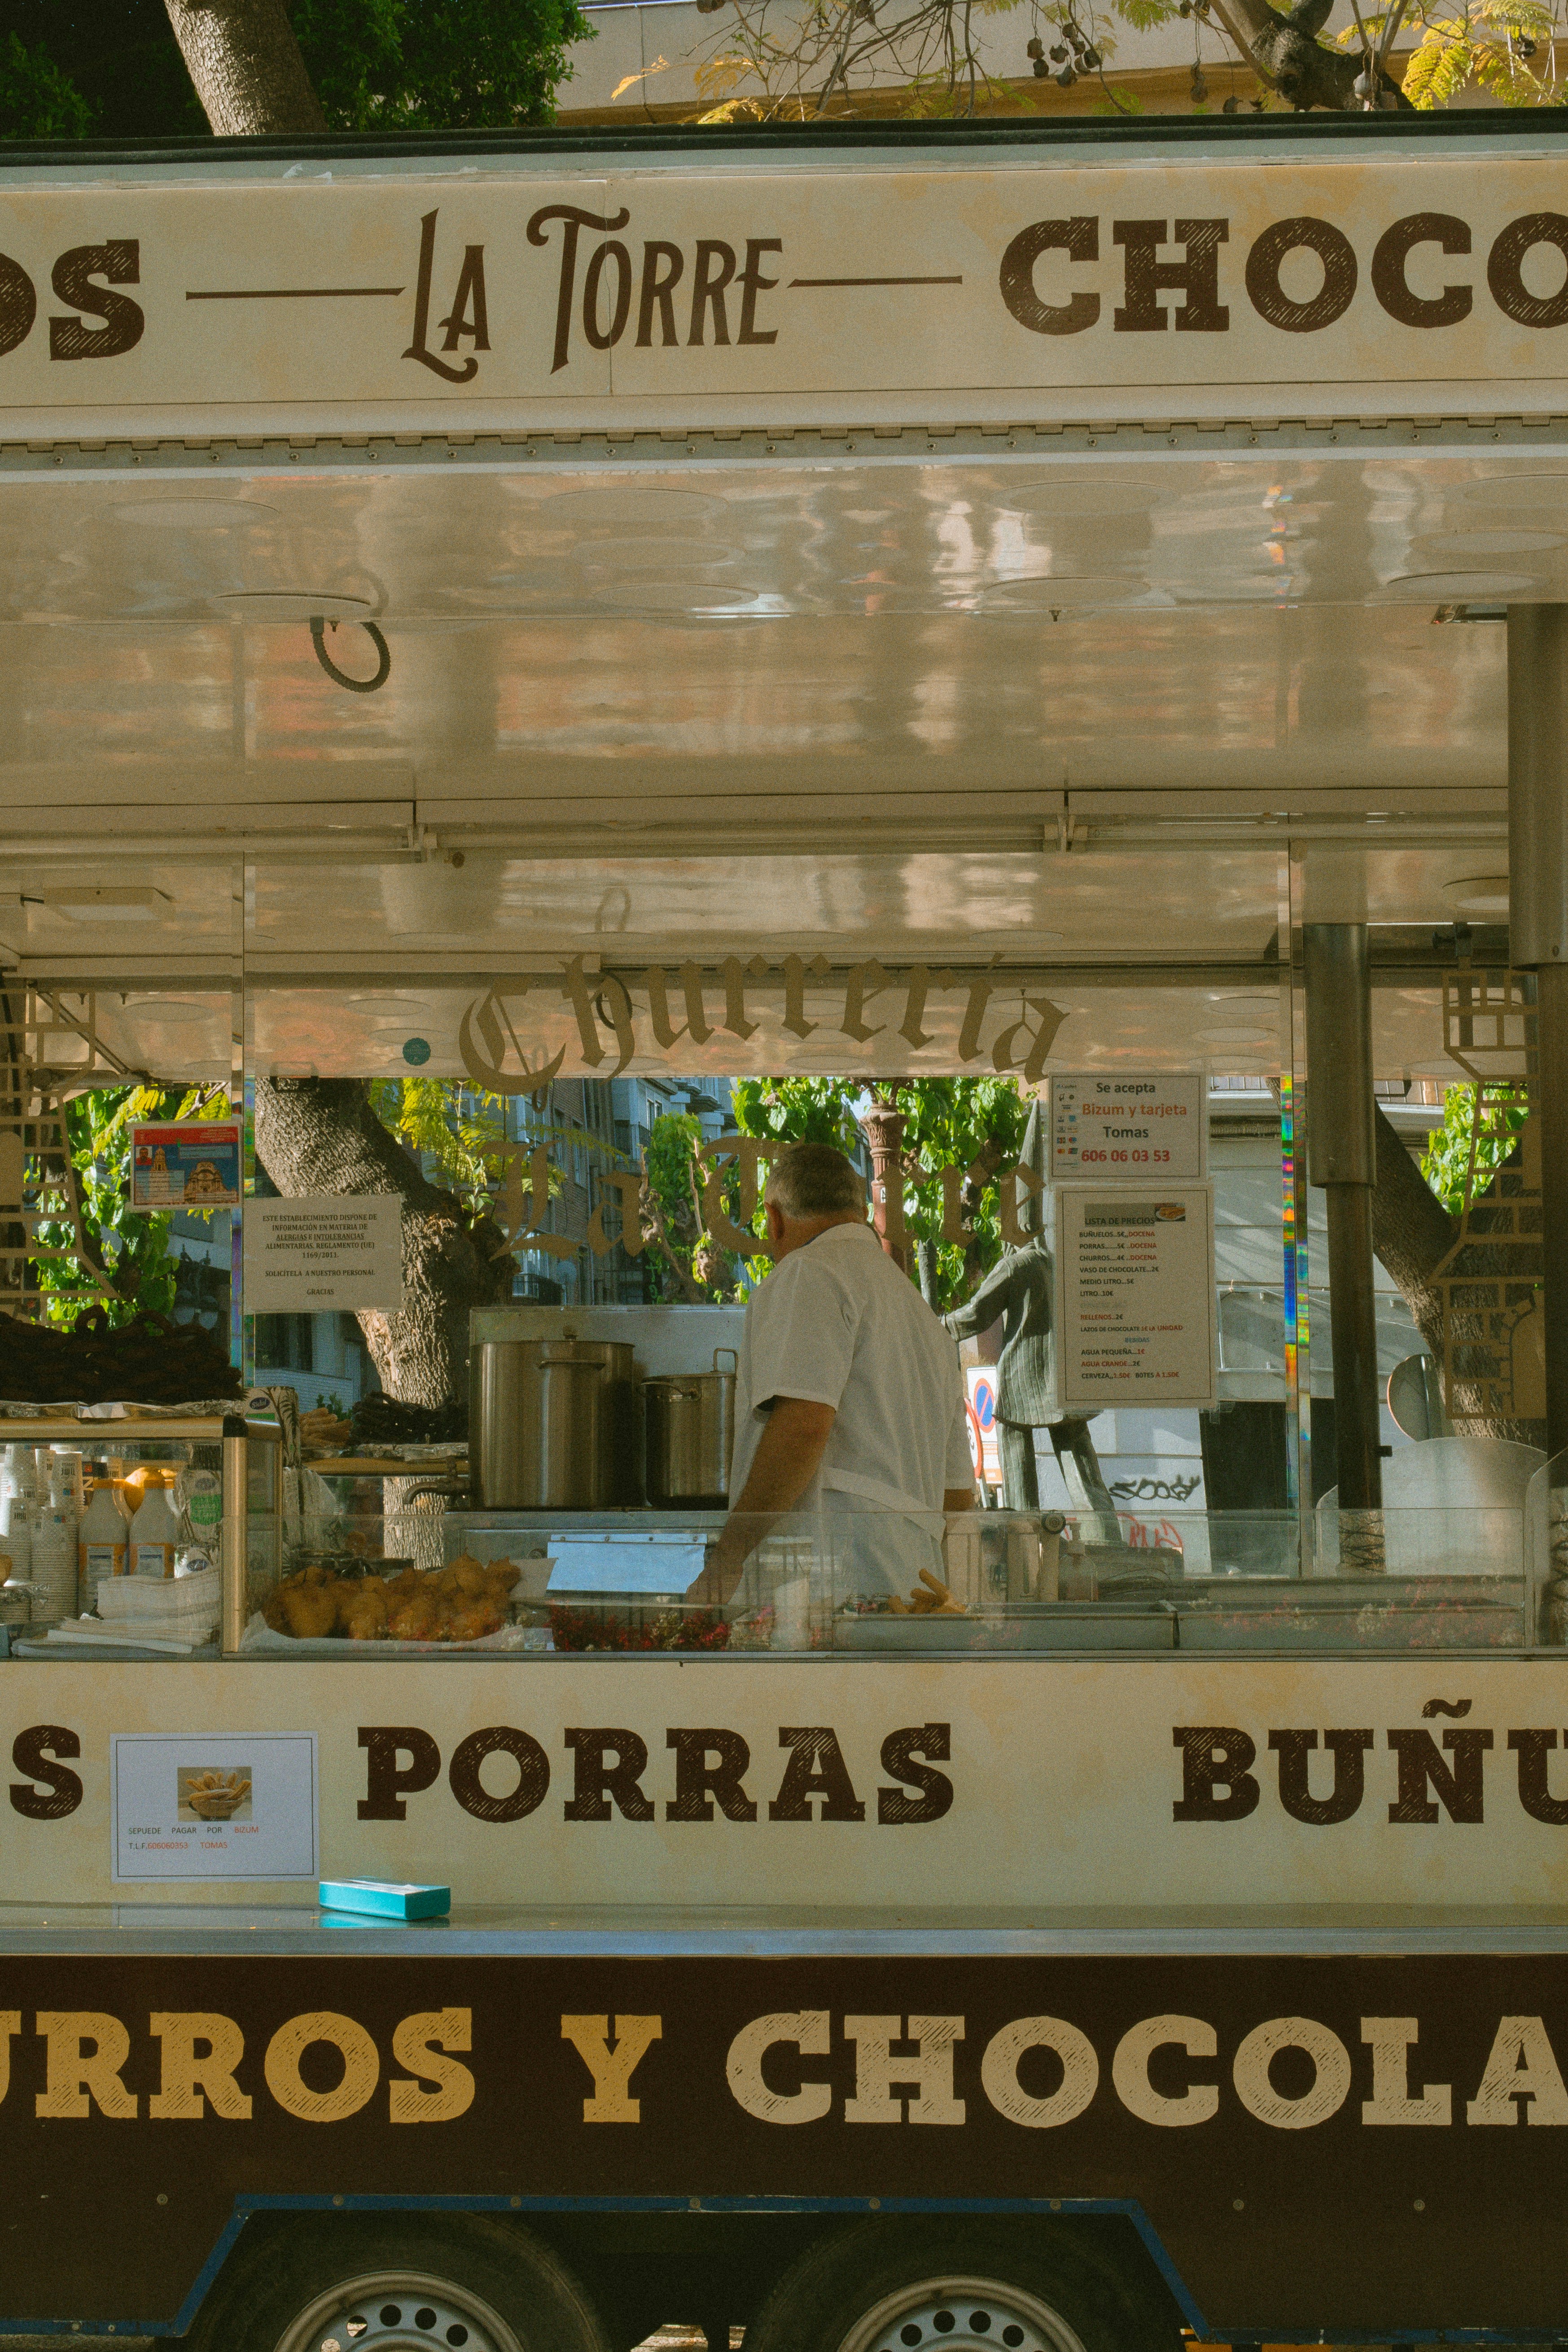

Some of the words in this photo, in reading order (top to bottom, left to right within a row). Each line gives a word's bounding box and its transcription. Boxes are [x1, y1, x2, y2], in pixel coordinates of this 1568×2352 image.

[402, 208, 491, 384] LA
[527, 205, 783, 374] TORRE
[999, 212, 1568, 335] CHOCO
[1082, 1104, 1124, 1115] Bizum
[1129, 1107, 1137, 1117] y
[1141, 1104, 1187, 1117] tarjeta
[1097, 1082, 1110, 1093] Se
[1115, 1082, 1155, 1095] acepta
[1104, 1126, 1149, 1138] Tomas
[477, 1139, 651, 1262] La
[696, 1134, 1046, 1257] Trre
[1082, 1150, 1107, 1162] 606
[1111, 1150, 1127, 1162] 06
[1132, 1150, 1149, 1162] 03
[1154, 1150, 1170, 1162] 53
[10, 1725, 83, 1820] S
[357, 1723, 954, 1825] PORRAS
[0, 2007, 475, 2124] RROS
[561, 2014, 662, 2123] Y
[725, 2010, 1568, 2129] CHOCOLA
